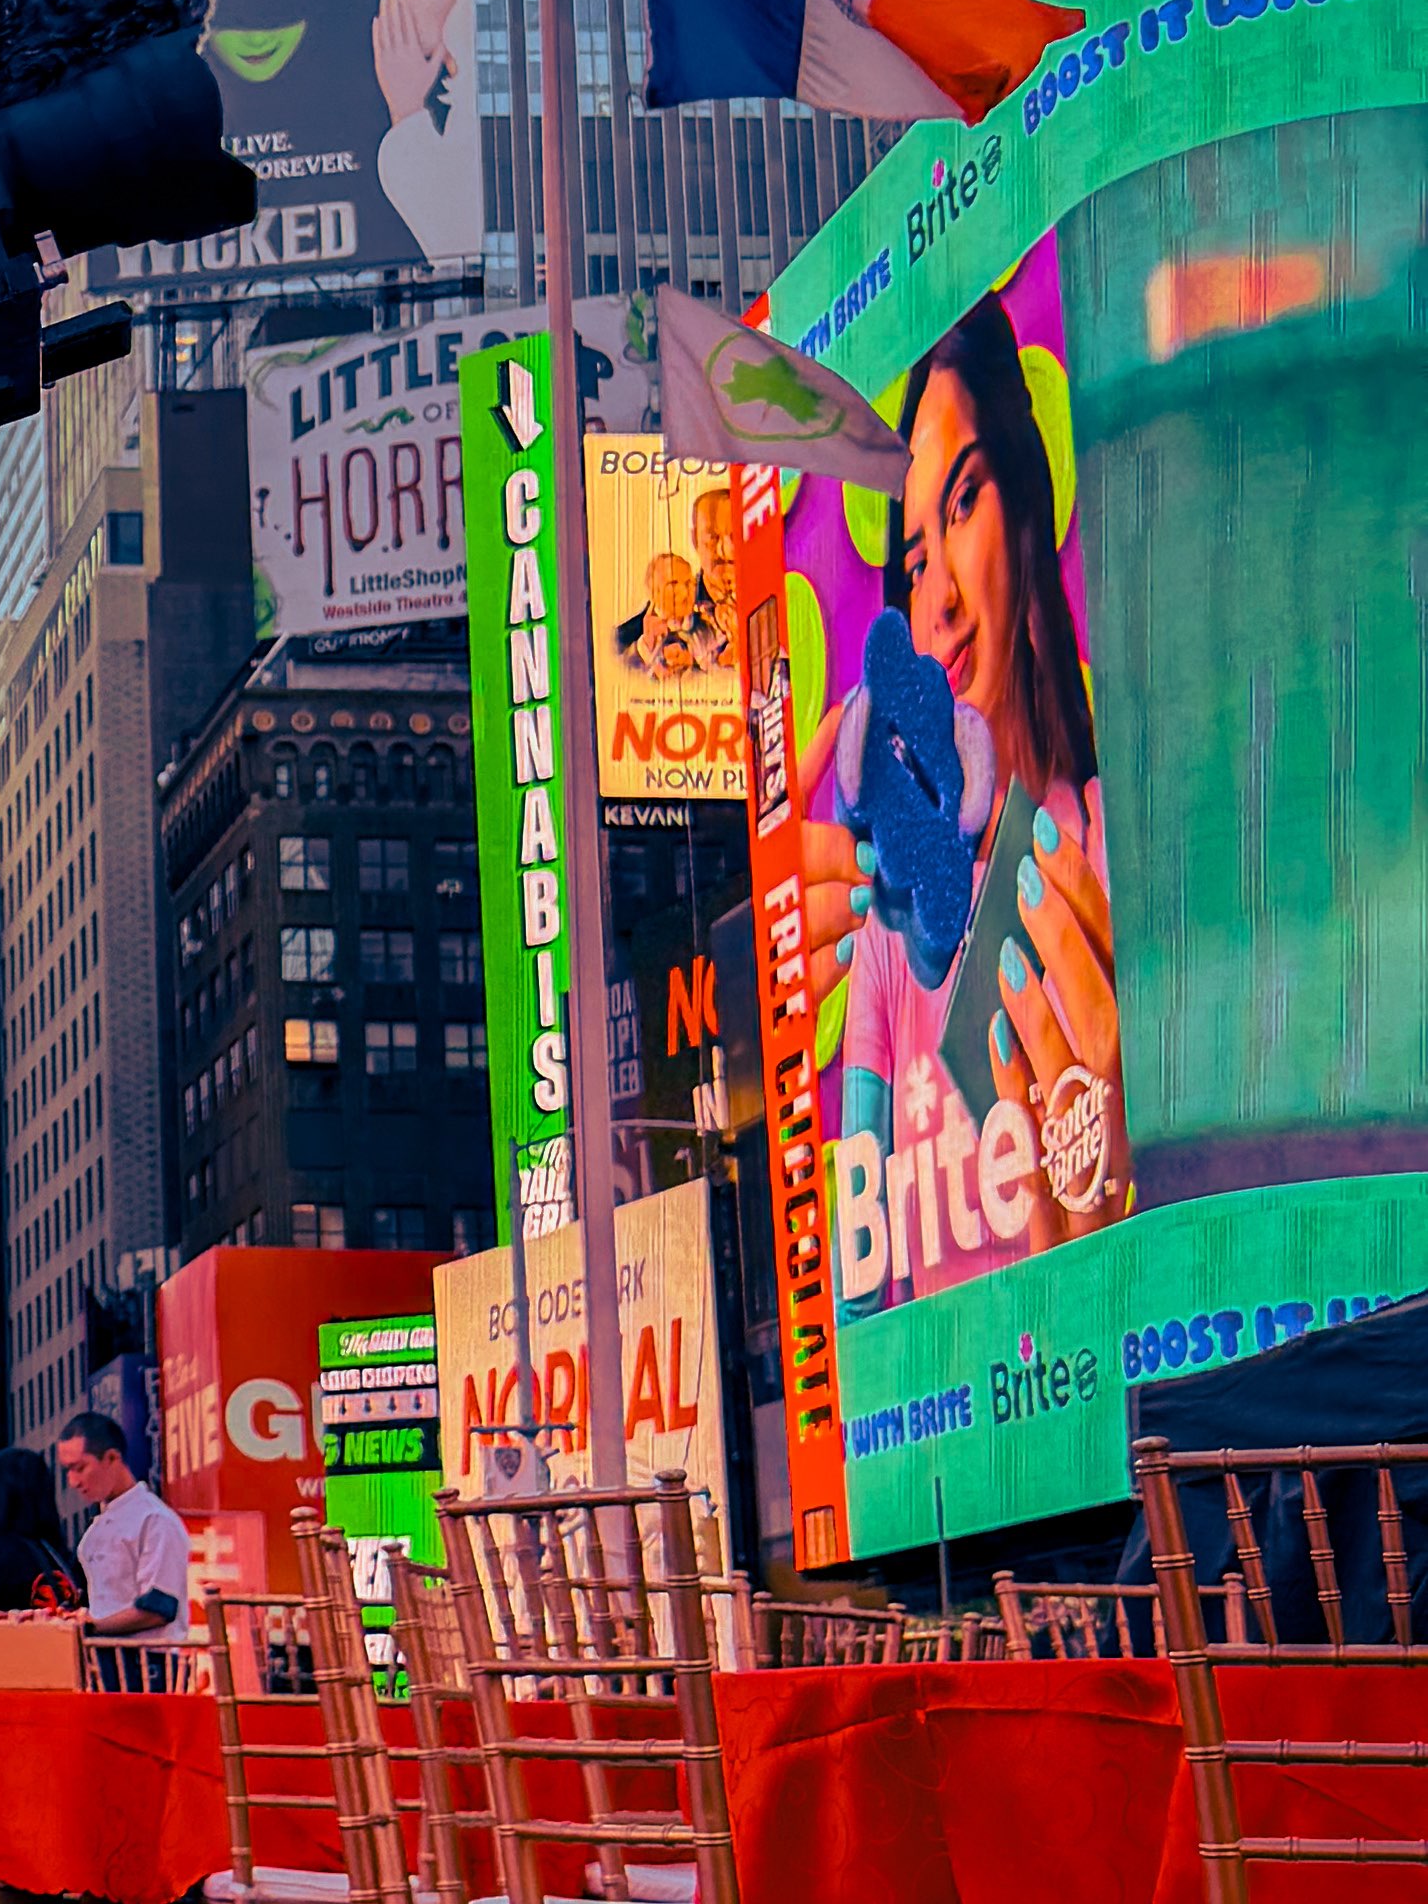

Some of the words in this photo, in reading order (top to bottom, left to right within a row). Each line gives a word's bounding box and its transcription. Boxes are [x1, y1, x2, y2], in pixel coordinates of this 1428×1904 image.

[1022, 21, 1130, 137] BOOST
[232, 130, 294, 157] LIVE.
[907, 158, 978, 268] Brite
[833, 247, 892, 337] BRITE
[290, 330, 464, 443] LITTLE
[323, 599, 391, 621] Westside
[396, 591, 454, 613] Theatre
[504, 467, 566, 1113] CANNABIS
[645, 766, 713, 791] NOW
[763, 872, 808, 1040] FREE
[832, 1052, 1038, 1300] Brite
[774, 1051, 834, 1444] CHOCOLATE
[989, 1332, 1071, 1425] Brite
[1122, 1308, 1245, 1380] BOOST
[165, 1381, 219, 1485] FIVE
[344, 1427, 425, 1467] NEWS
[461, 1316, 698, 1477] NORAL
[851, 1404, 904, 1459] WITH
[908, 1383, 973, 1443] BRITE
